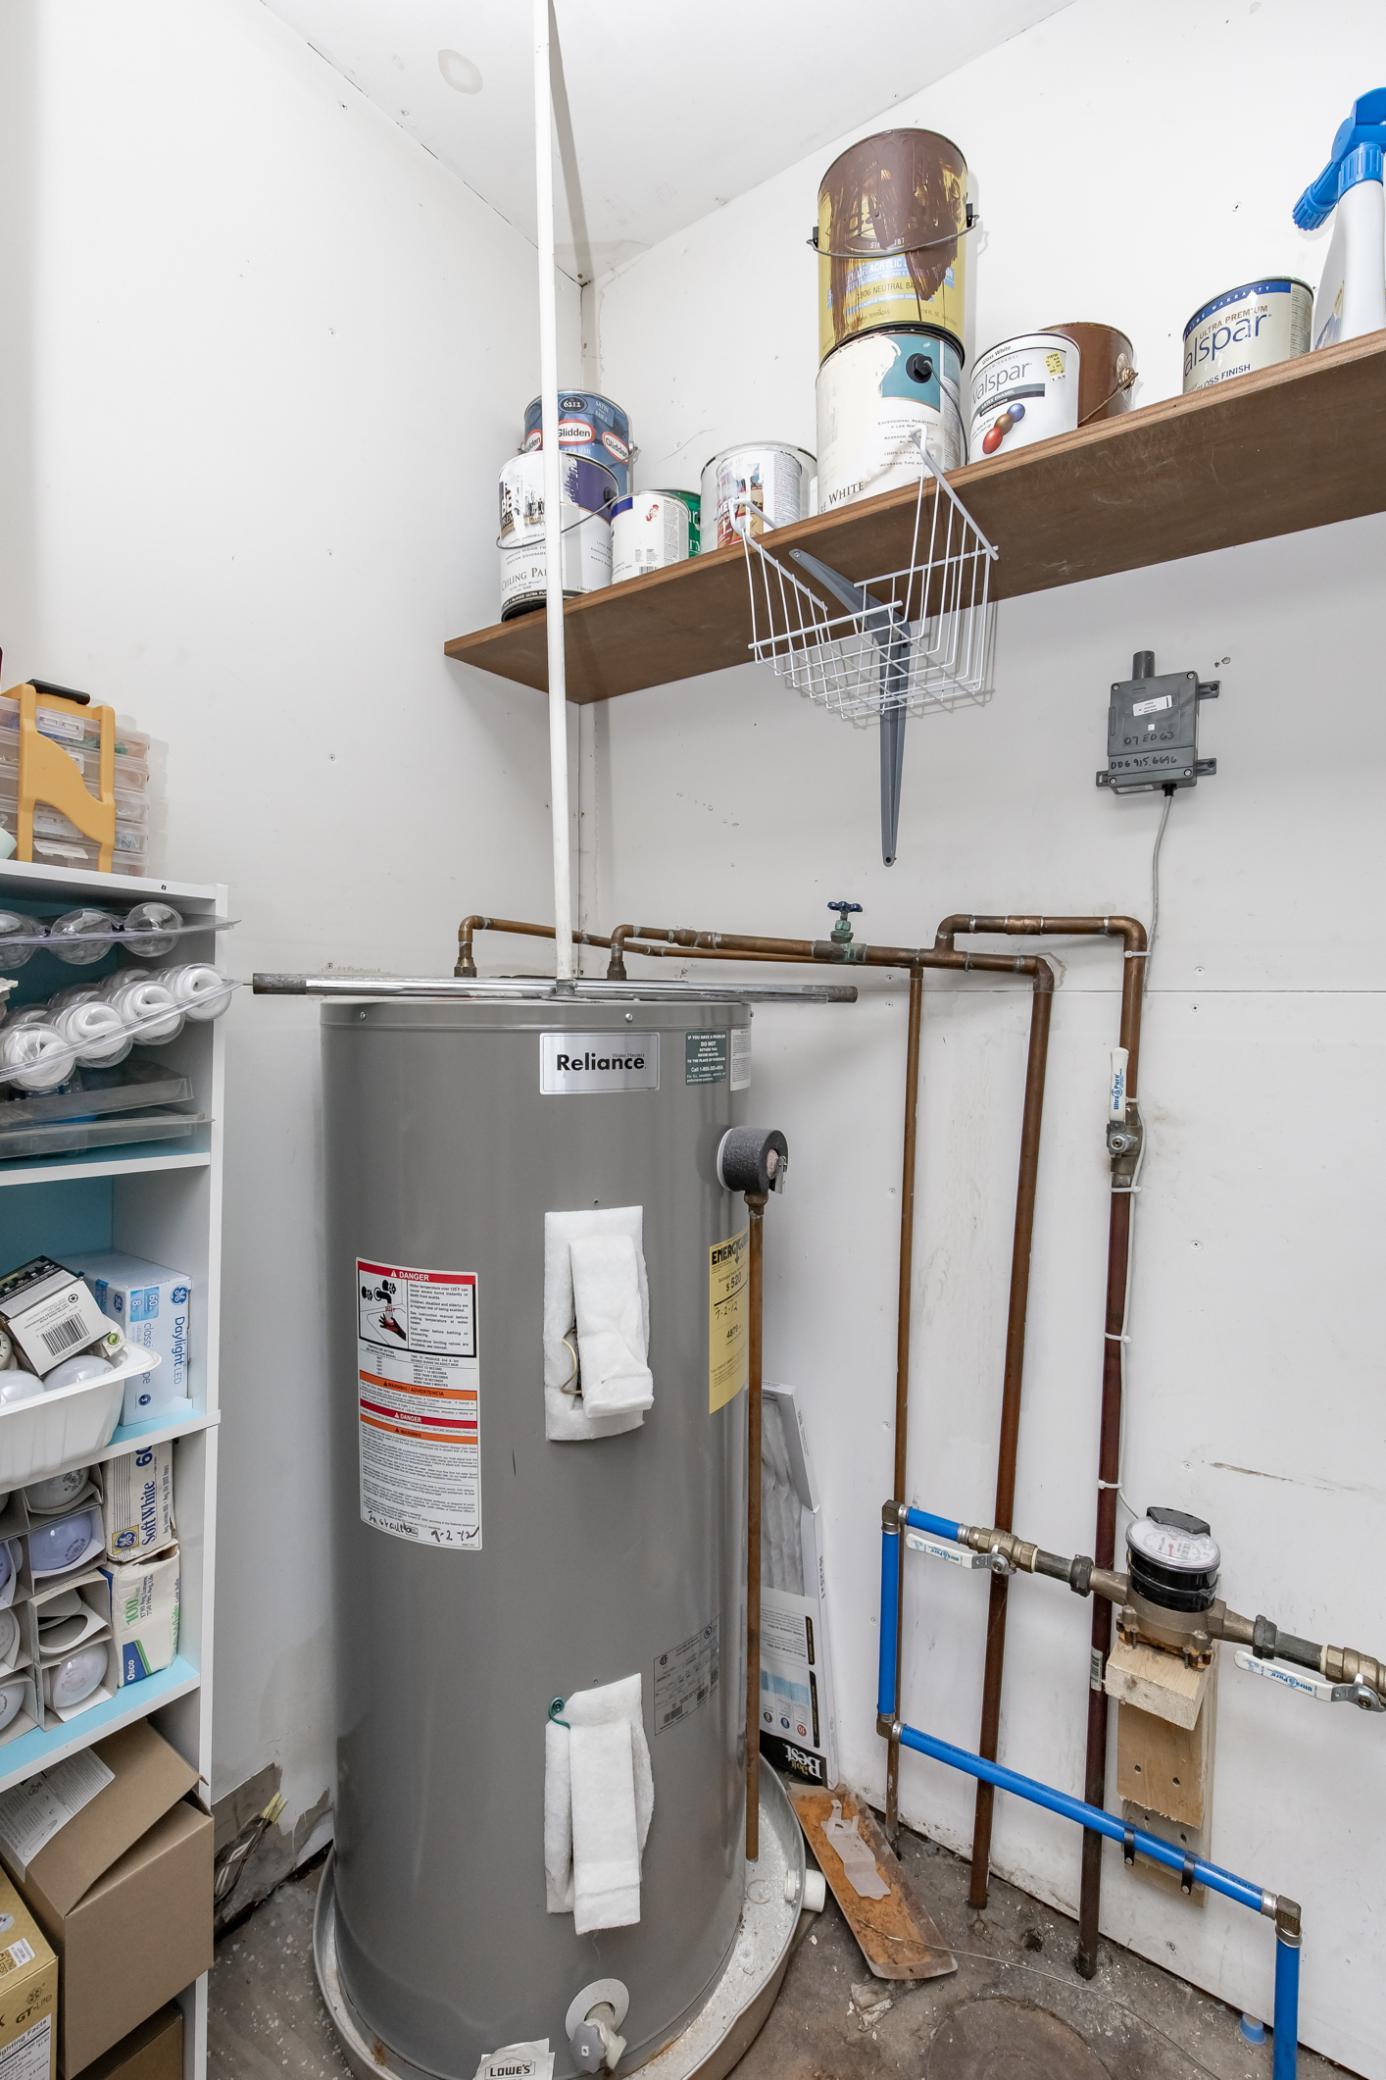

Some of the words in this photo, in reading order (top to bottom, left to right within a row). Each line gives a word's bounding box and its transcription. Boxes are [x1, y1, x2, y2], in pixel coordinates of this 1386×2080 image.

[872, 280, 904, 295] NEUTRAL
[1200, 320, 1222, 339] ULTRA
[1184, 314, 1268, 377] alspar
[1221, 364, 1250, 380] FINISH
[828, 481, 864, 504] WHITE
[531, 567, 546, 578] PAI
[556, 1052, 645, 1071] Reliance
[399, 1271, 430, 1281] DANGER
[170, 1316, 185, 1367] Daylight
[400, 1414, 422, 1423] DANGER
[140, 1481, 156, 1521] White
[141, 1518, 157, 1546] Soft
[785, 1744, 823, 1779] Best
[490, 2064, 530, 2077] LOWE'S
